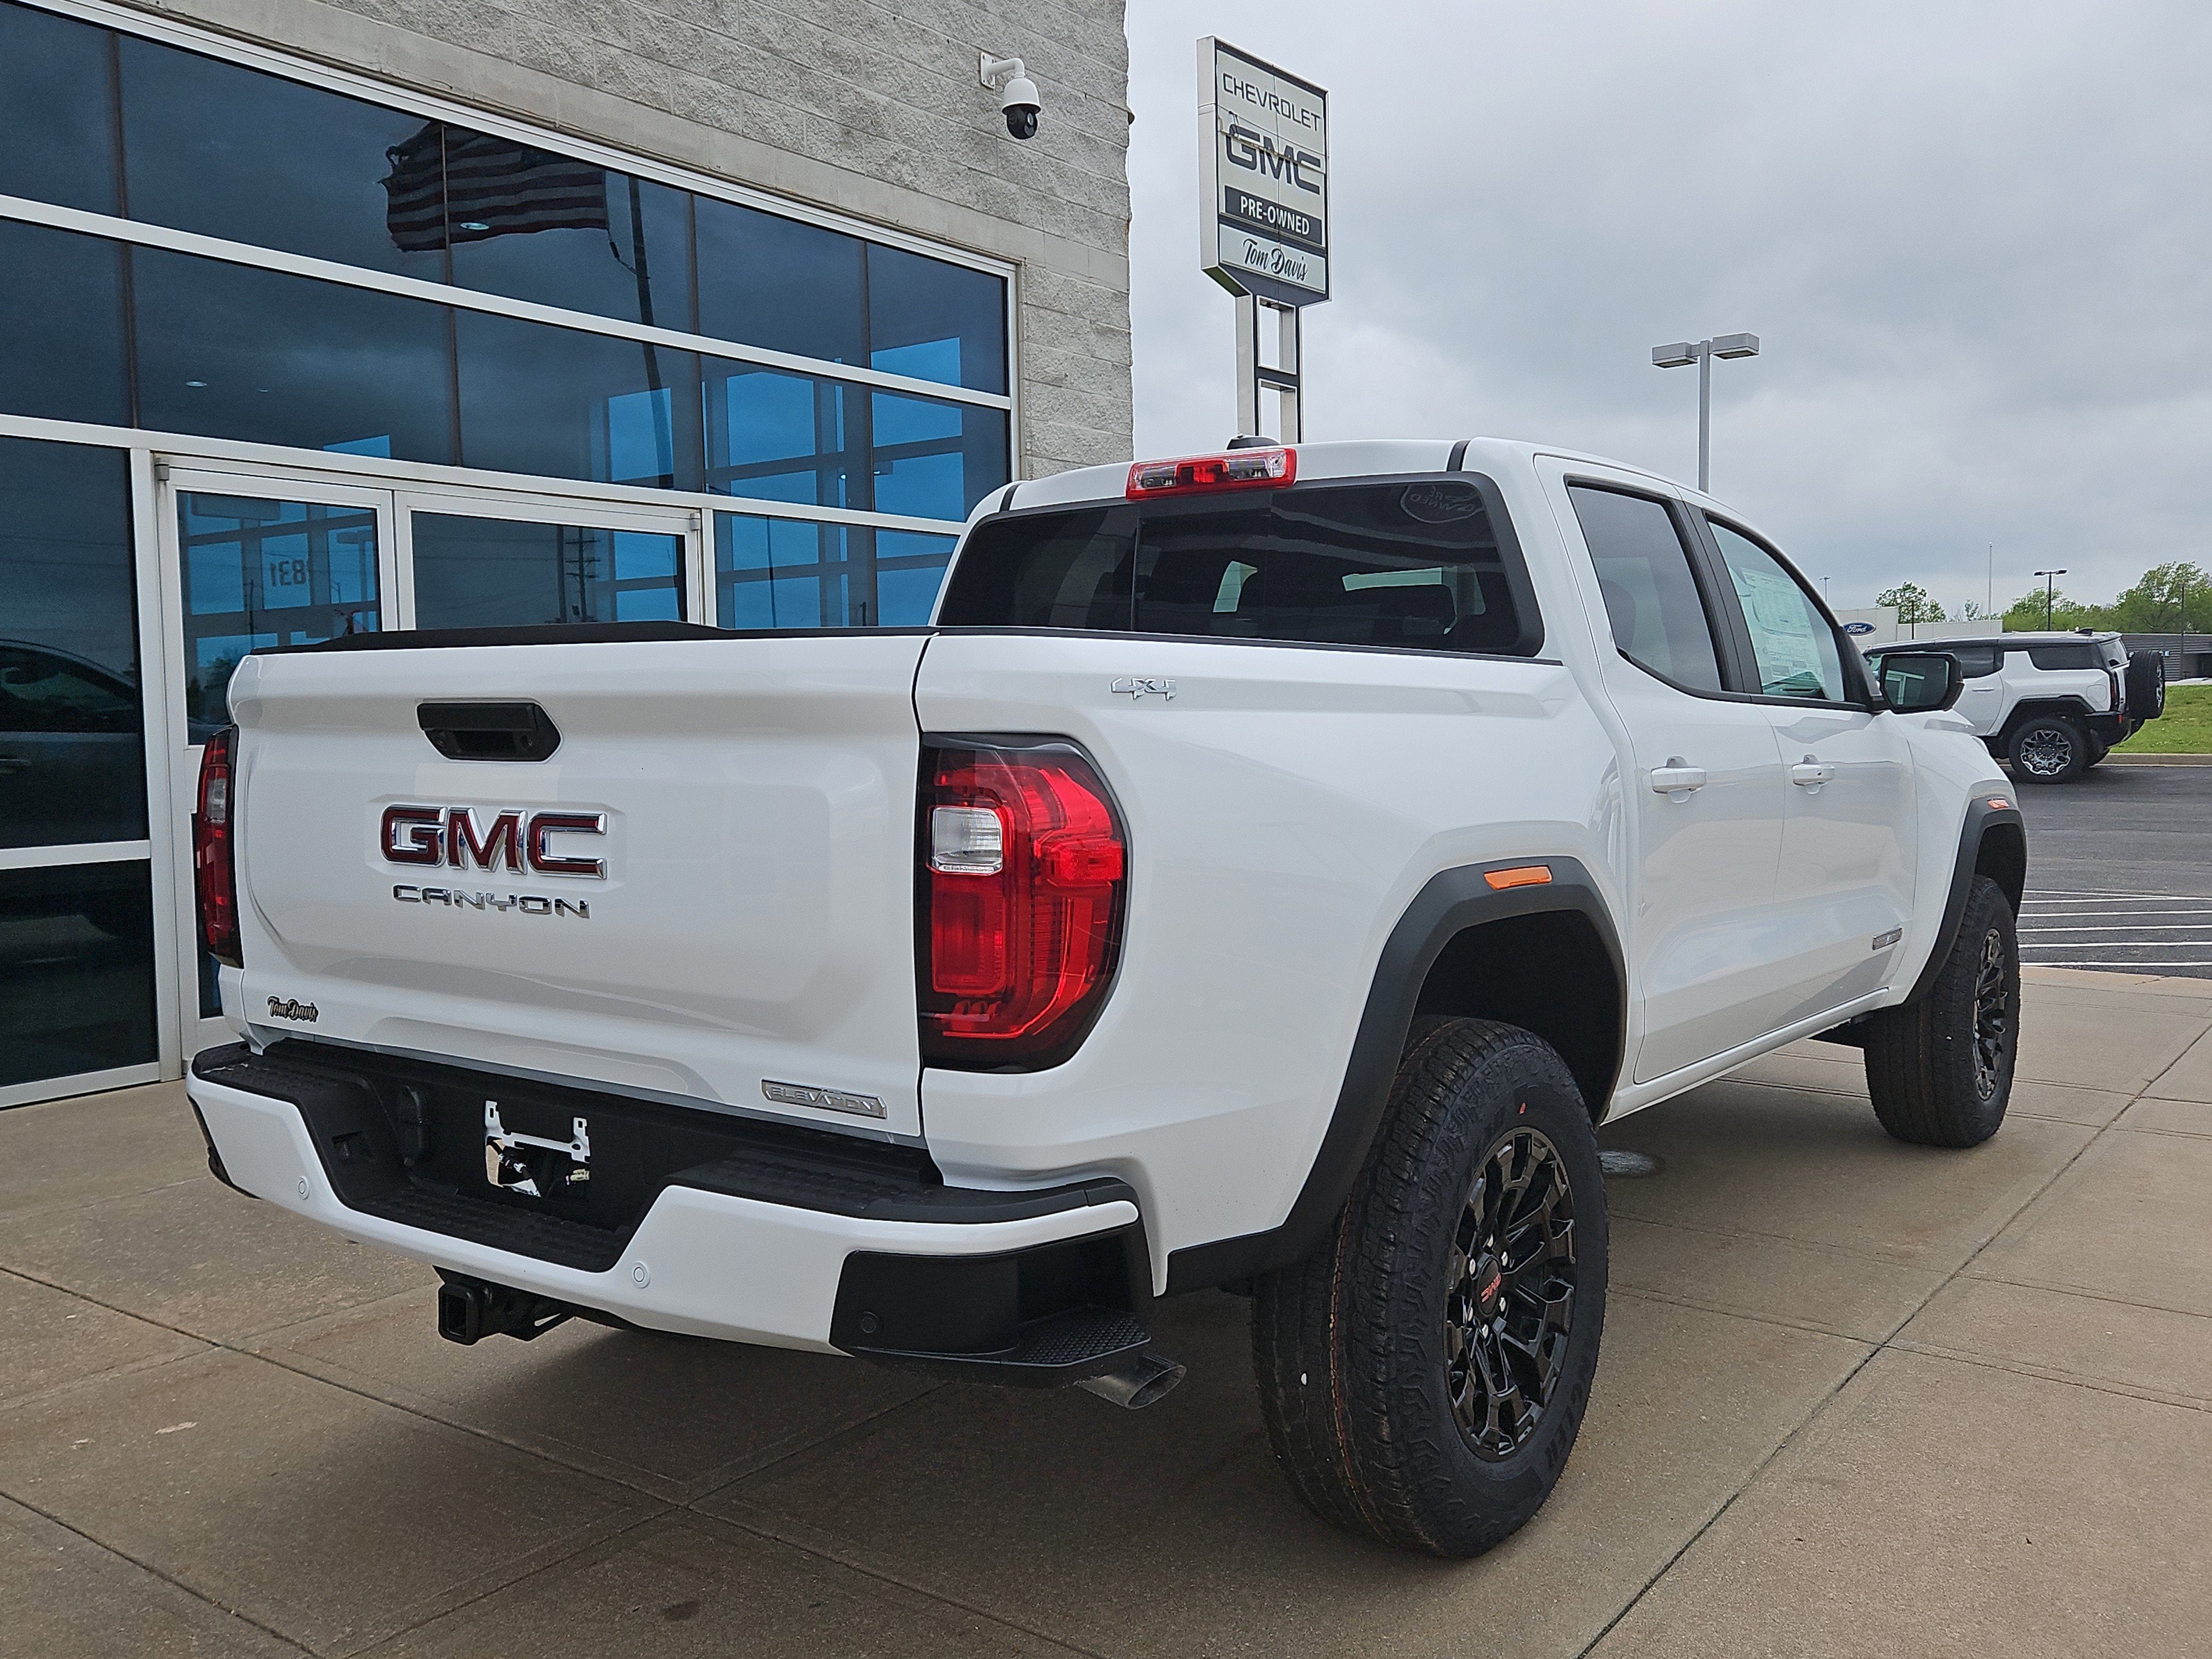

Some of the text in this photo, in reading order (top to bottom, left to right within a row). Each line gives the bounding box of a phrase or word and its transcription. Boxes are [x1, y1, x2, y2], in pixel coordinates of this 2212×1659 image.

[1223, 72, 1322, 132] CHEVROLET
[1226, 124, 1321, 195] GMC
[1240, 195, 1310, 235] PRE-OWNED
[1243, 238, 1308, 281] Tom Davis
[1847, 624, 1868, 633] Ford
[380, 803, 608, 880] GMC
[393, 884, 590, 919] CANYON
[267, 996, 319, 1023] Tom Davis
[769, 1084, 877, 1113] ELEVATION
[1481, 1272, 1501, 1303] GMC
